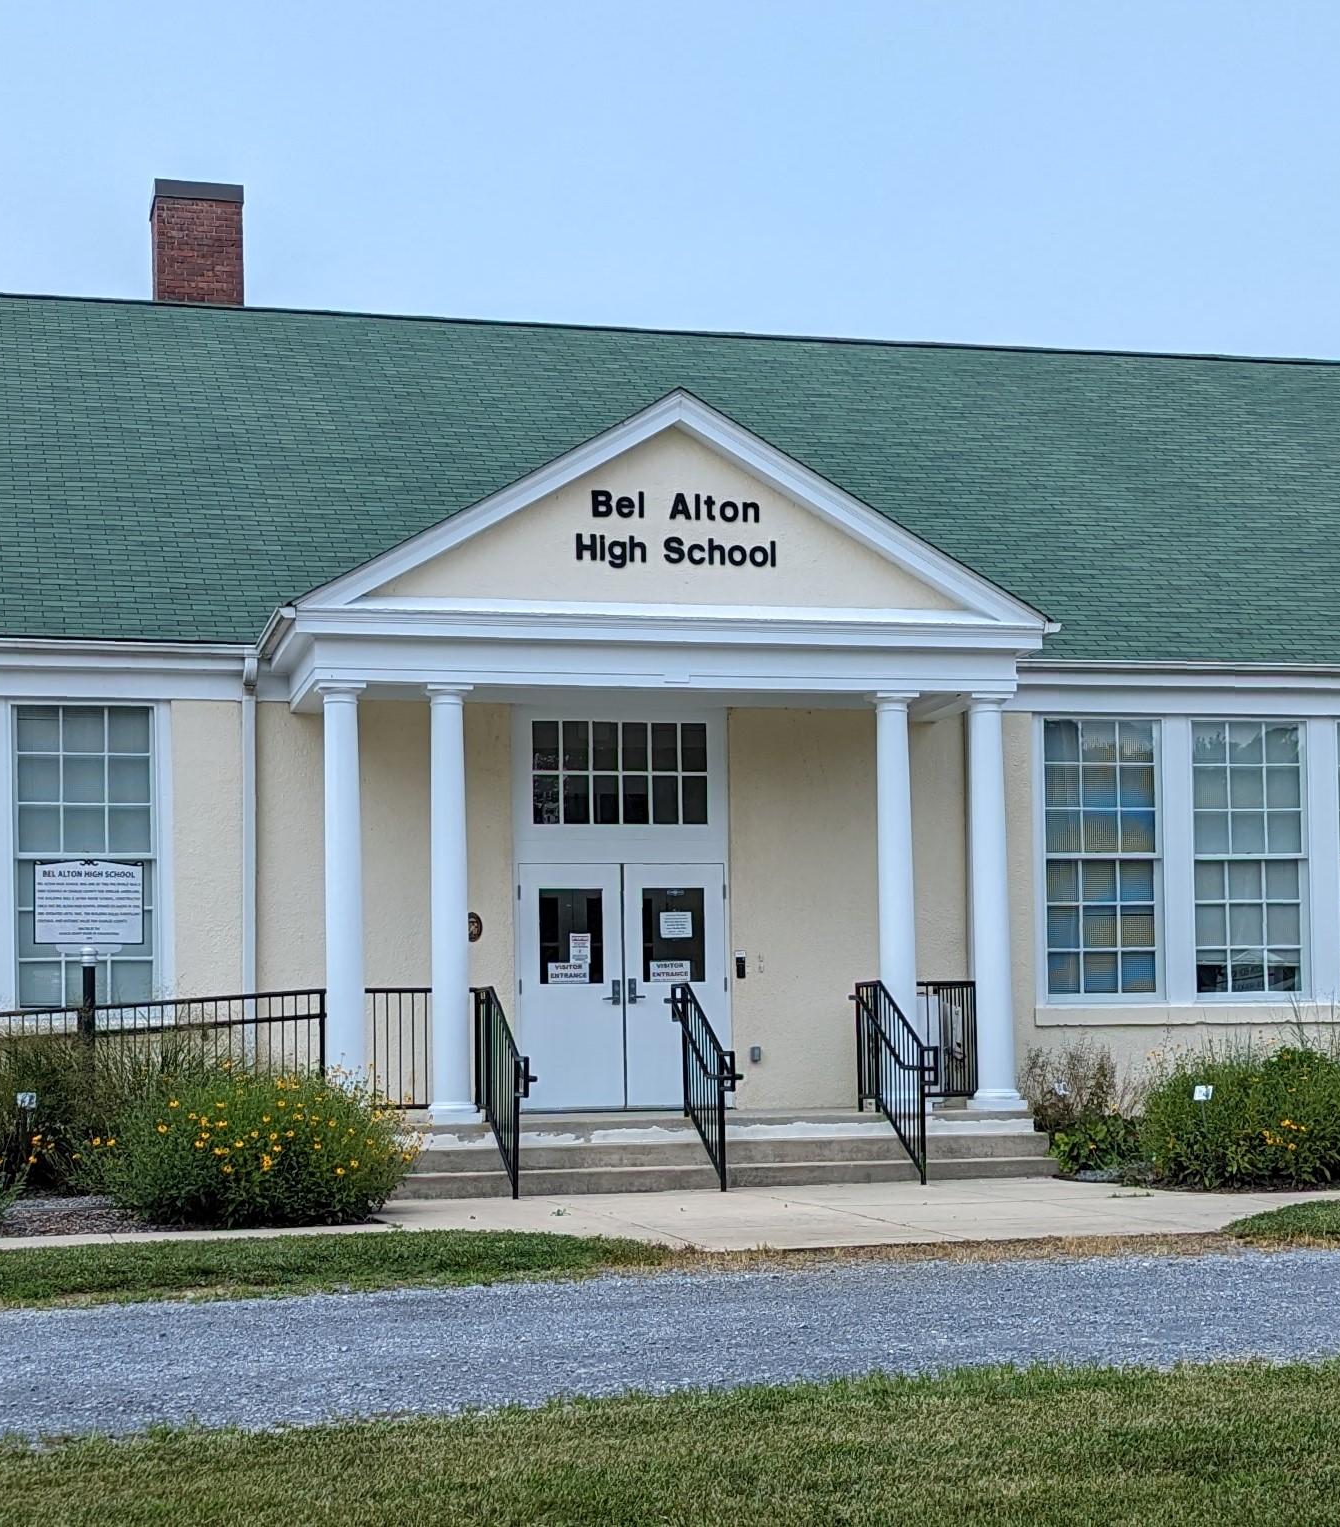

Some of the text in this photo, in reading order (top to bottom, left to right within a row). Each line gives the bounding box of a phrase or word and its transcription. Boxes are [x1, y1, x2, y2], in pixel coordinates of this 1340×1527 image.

[591, 489, 760, 523] Bel Alton
[576, 532, 777, 569] High School
[42, 870, 136, 878] BEL ALTON HIGH SCHOOL
